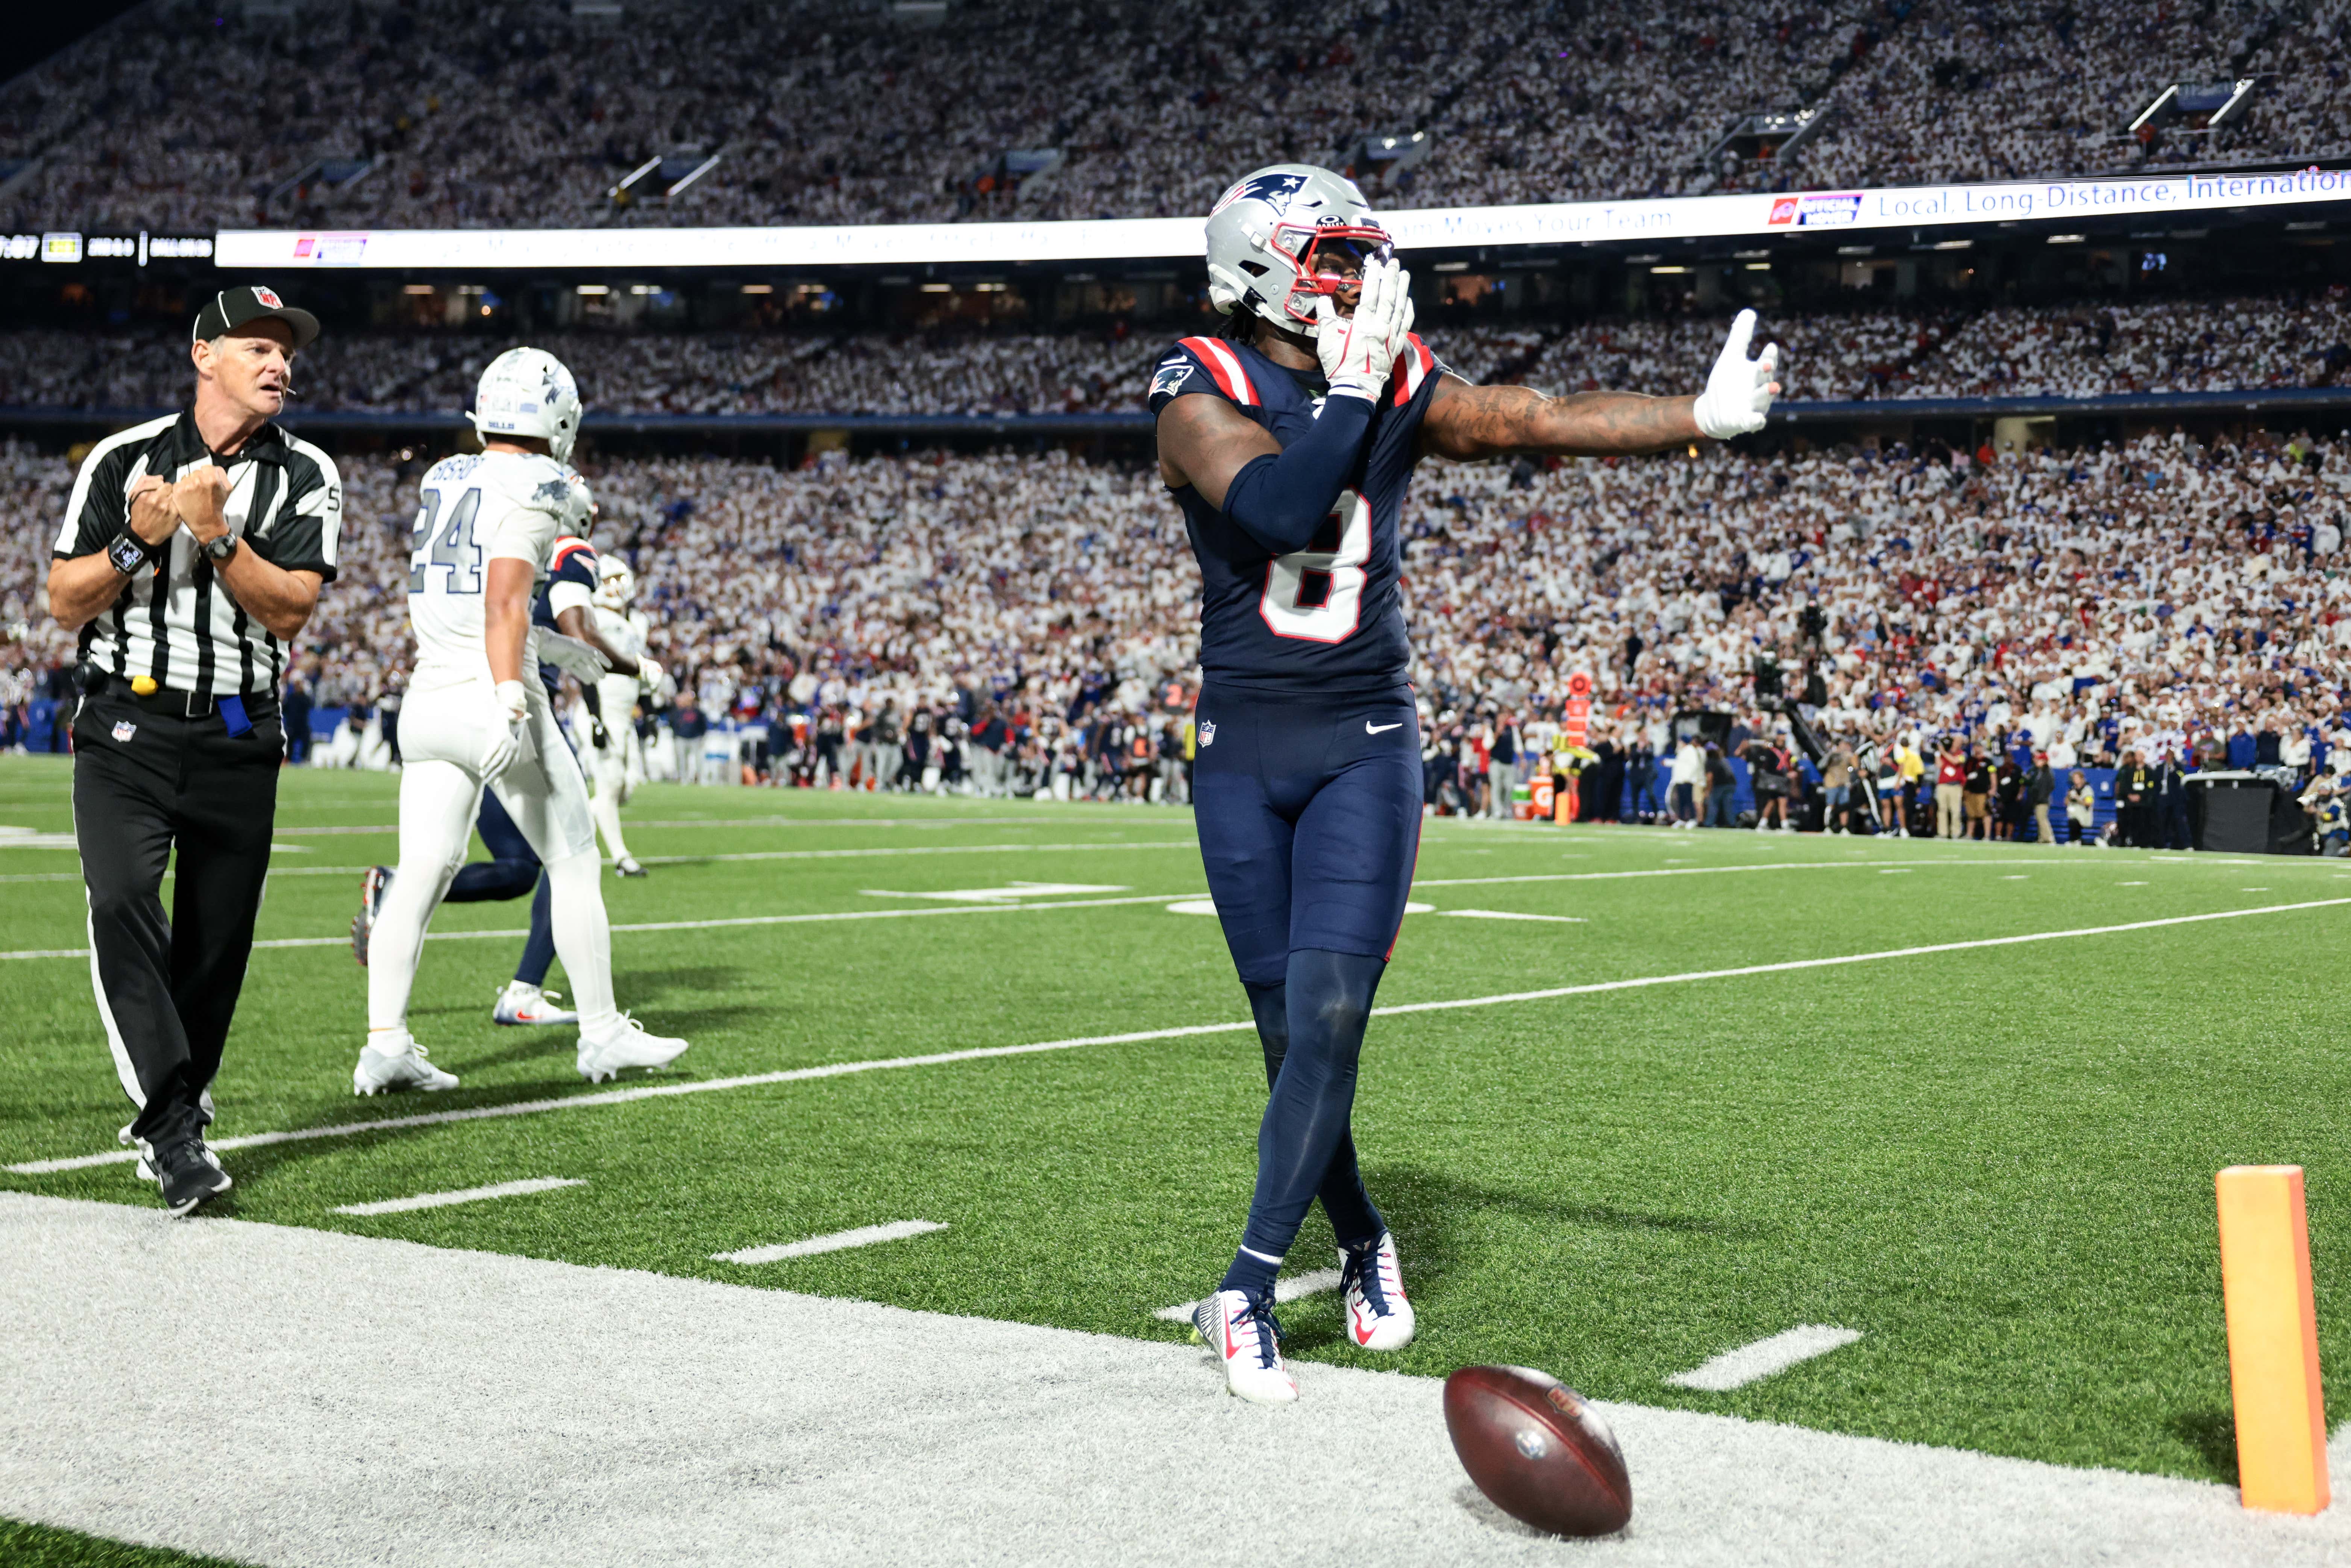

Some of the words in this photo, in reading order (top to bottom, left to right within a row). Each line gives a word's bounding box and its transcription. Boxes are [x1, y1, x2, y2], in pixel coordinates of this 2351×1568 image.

[1881, 190, 1955, 216] Local,
[1967, 182, 2177, 215] Long-Distance,
[1534, 213, 1592, 231] Your
[1603, 208, 1671, 229] Team
[327, 486, 340, 512] 5
[408, 487, 481, 594] 24
[1258, 484, 1372, 644] 8
[1200, 731, 1210, 743] NFL
